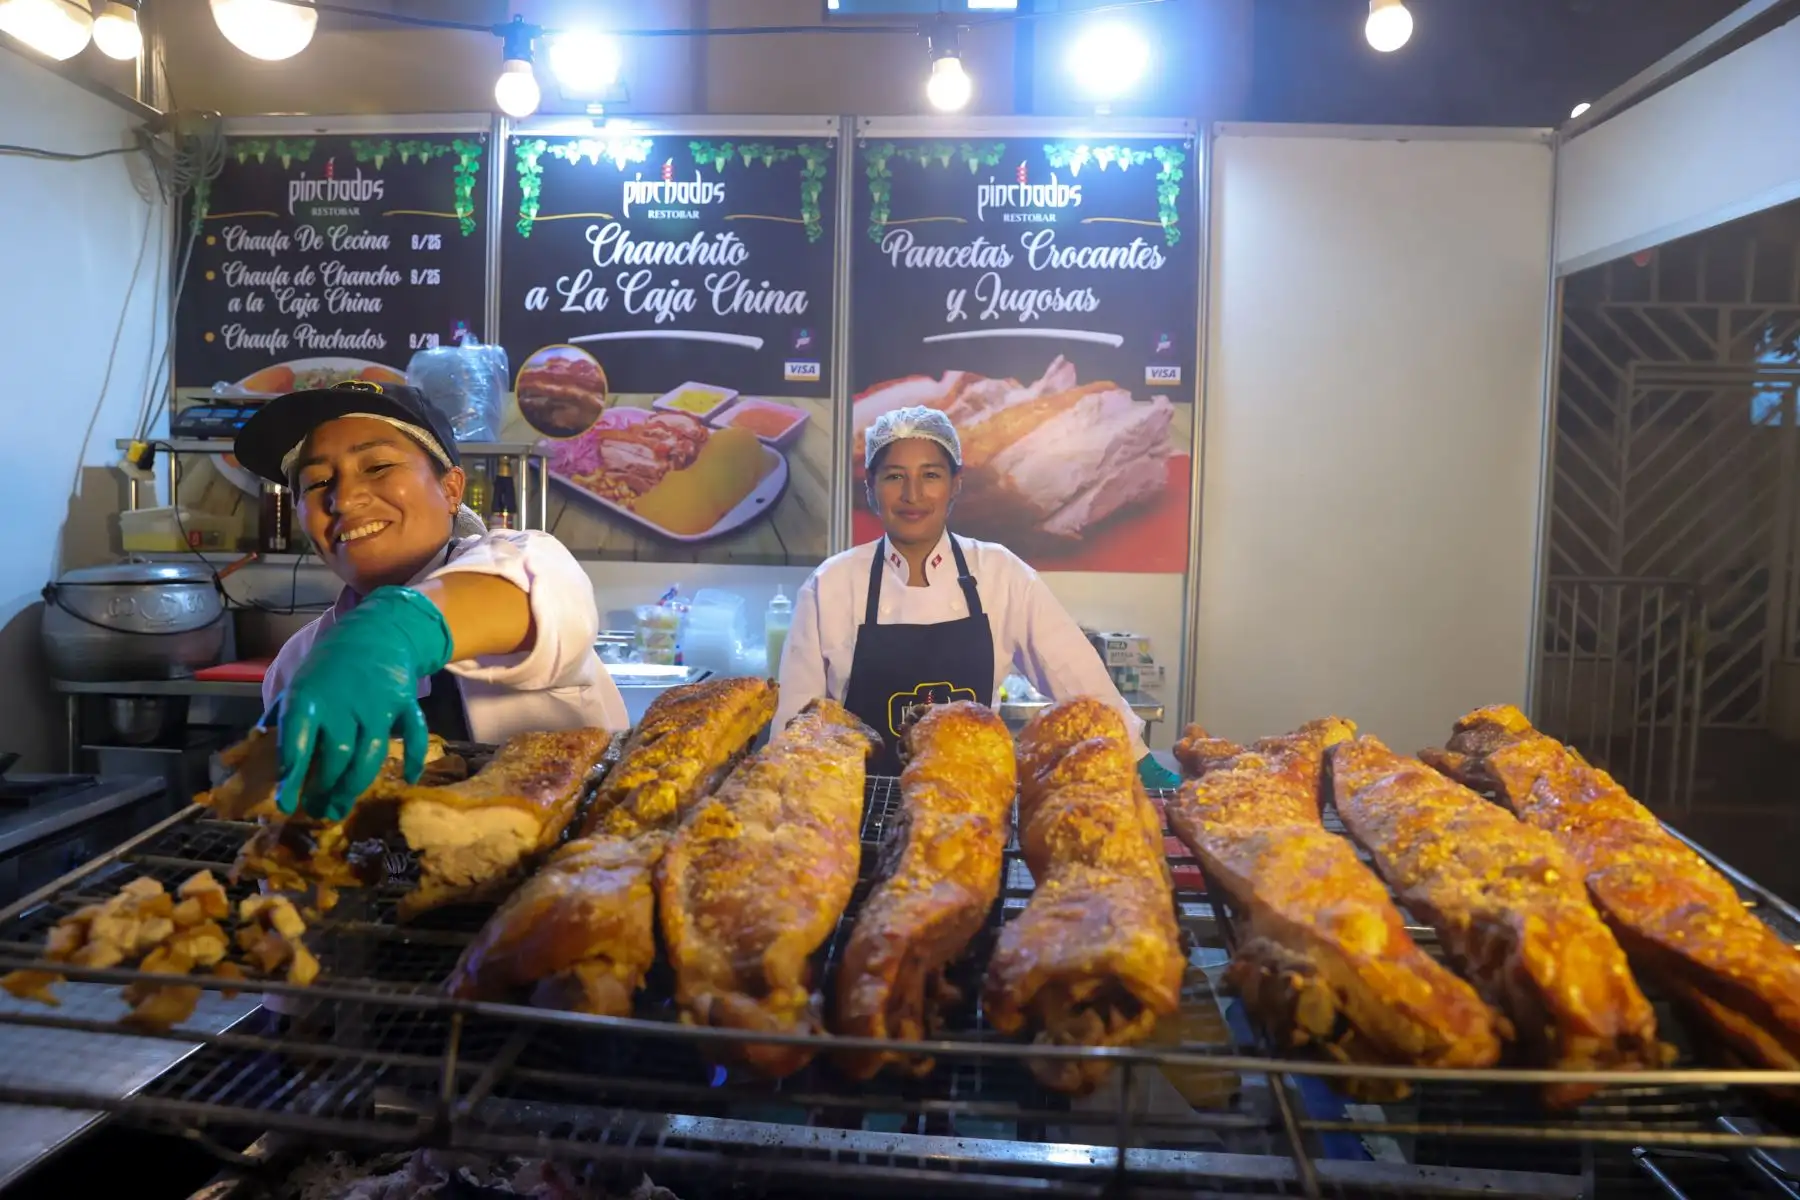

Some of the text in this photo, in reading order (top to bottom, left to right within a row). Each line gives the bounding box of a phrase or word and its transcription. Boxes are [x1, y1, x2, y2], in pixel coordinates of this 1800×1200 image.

[311, 206, 361, 217] RESTOBAR
[647, 208, 700, 220] RESTOBAR
[1003, 212, 1057, 223] RESTOBAR
[221, 224, 291, 257] Chaufa
[294, 224, 324, 252] De
[326, 224, 390, 252] Cecina
[585, 222, 750, 267] Chanchito
[881, 228, 1166, 271] Pancetas Crocantes
[221, 260, 291, 292] Chaufa
[293, 264, 317, 287] de
[319, 260, 402, 288] Chancho
[228, 286, 383, 318] a la Caja China
[524, 269, 809, 324] a La Caja China
[946, 271, 1100, 322] y Jugosas
[220, 323, 290, 356] Chaufa
[293, 324, 387, 350] Pinchados
[790, 364, 816, 375] VISA
[1151, 368, 1177, 379] VISA
